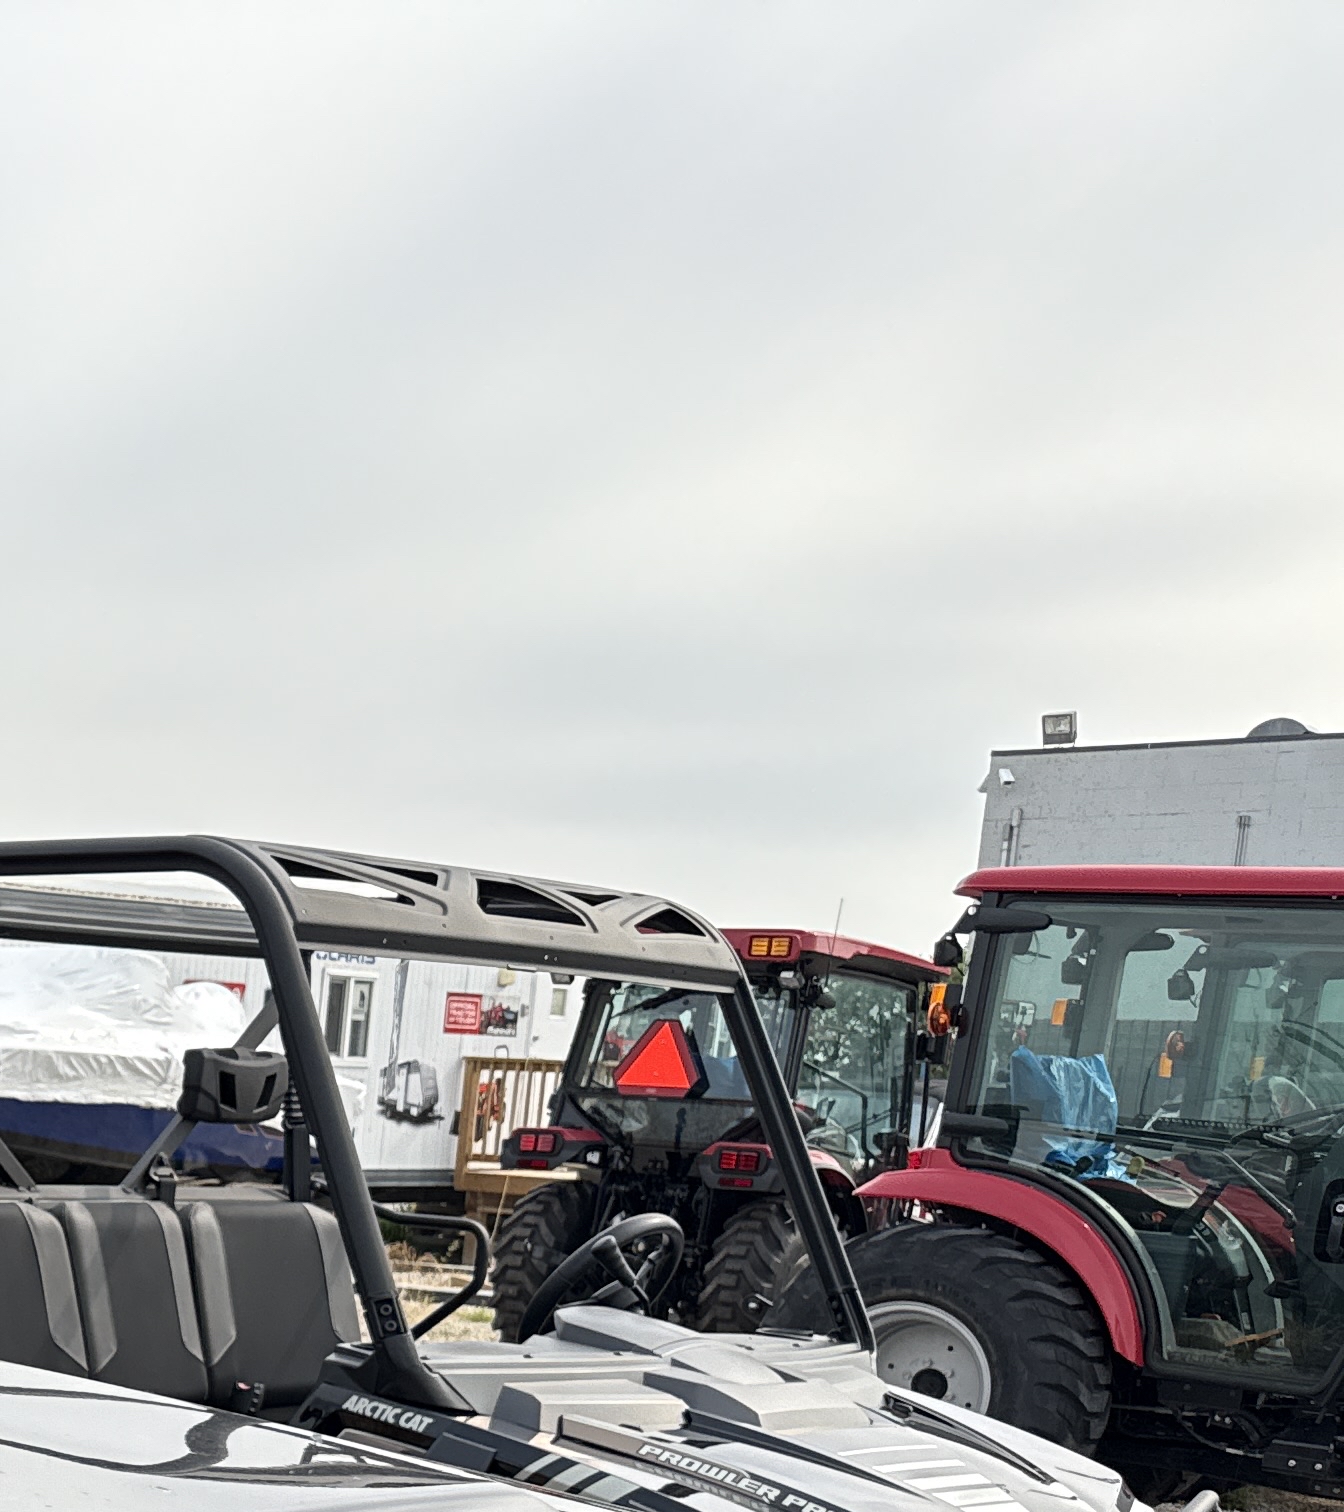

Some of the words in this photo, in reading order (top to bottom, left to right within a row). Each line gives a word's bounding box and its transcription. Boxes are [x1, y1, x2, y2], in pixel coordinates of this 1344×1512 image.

[342, 1394, 397, 1425] ARCTIC
[398, 1410, 434, 1433] CAT
[638, 1444, 781, 1504] PROWLER
